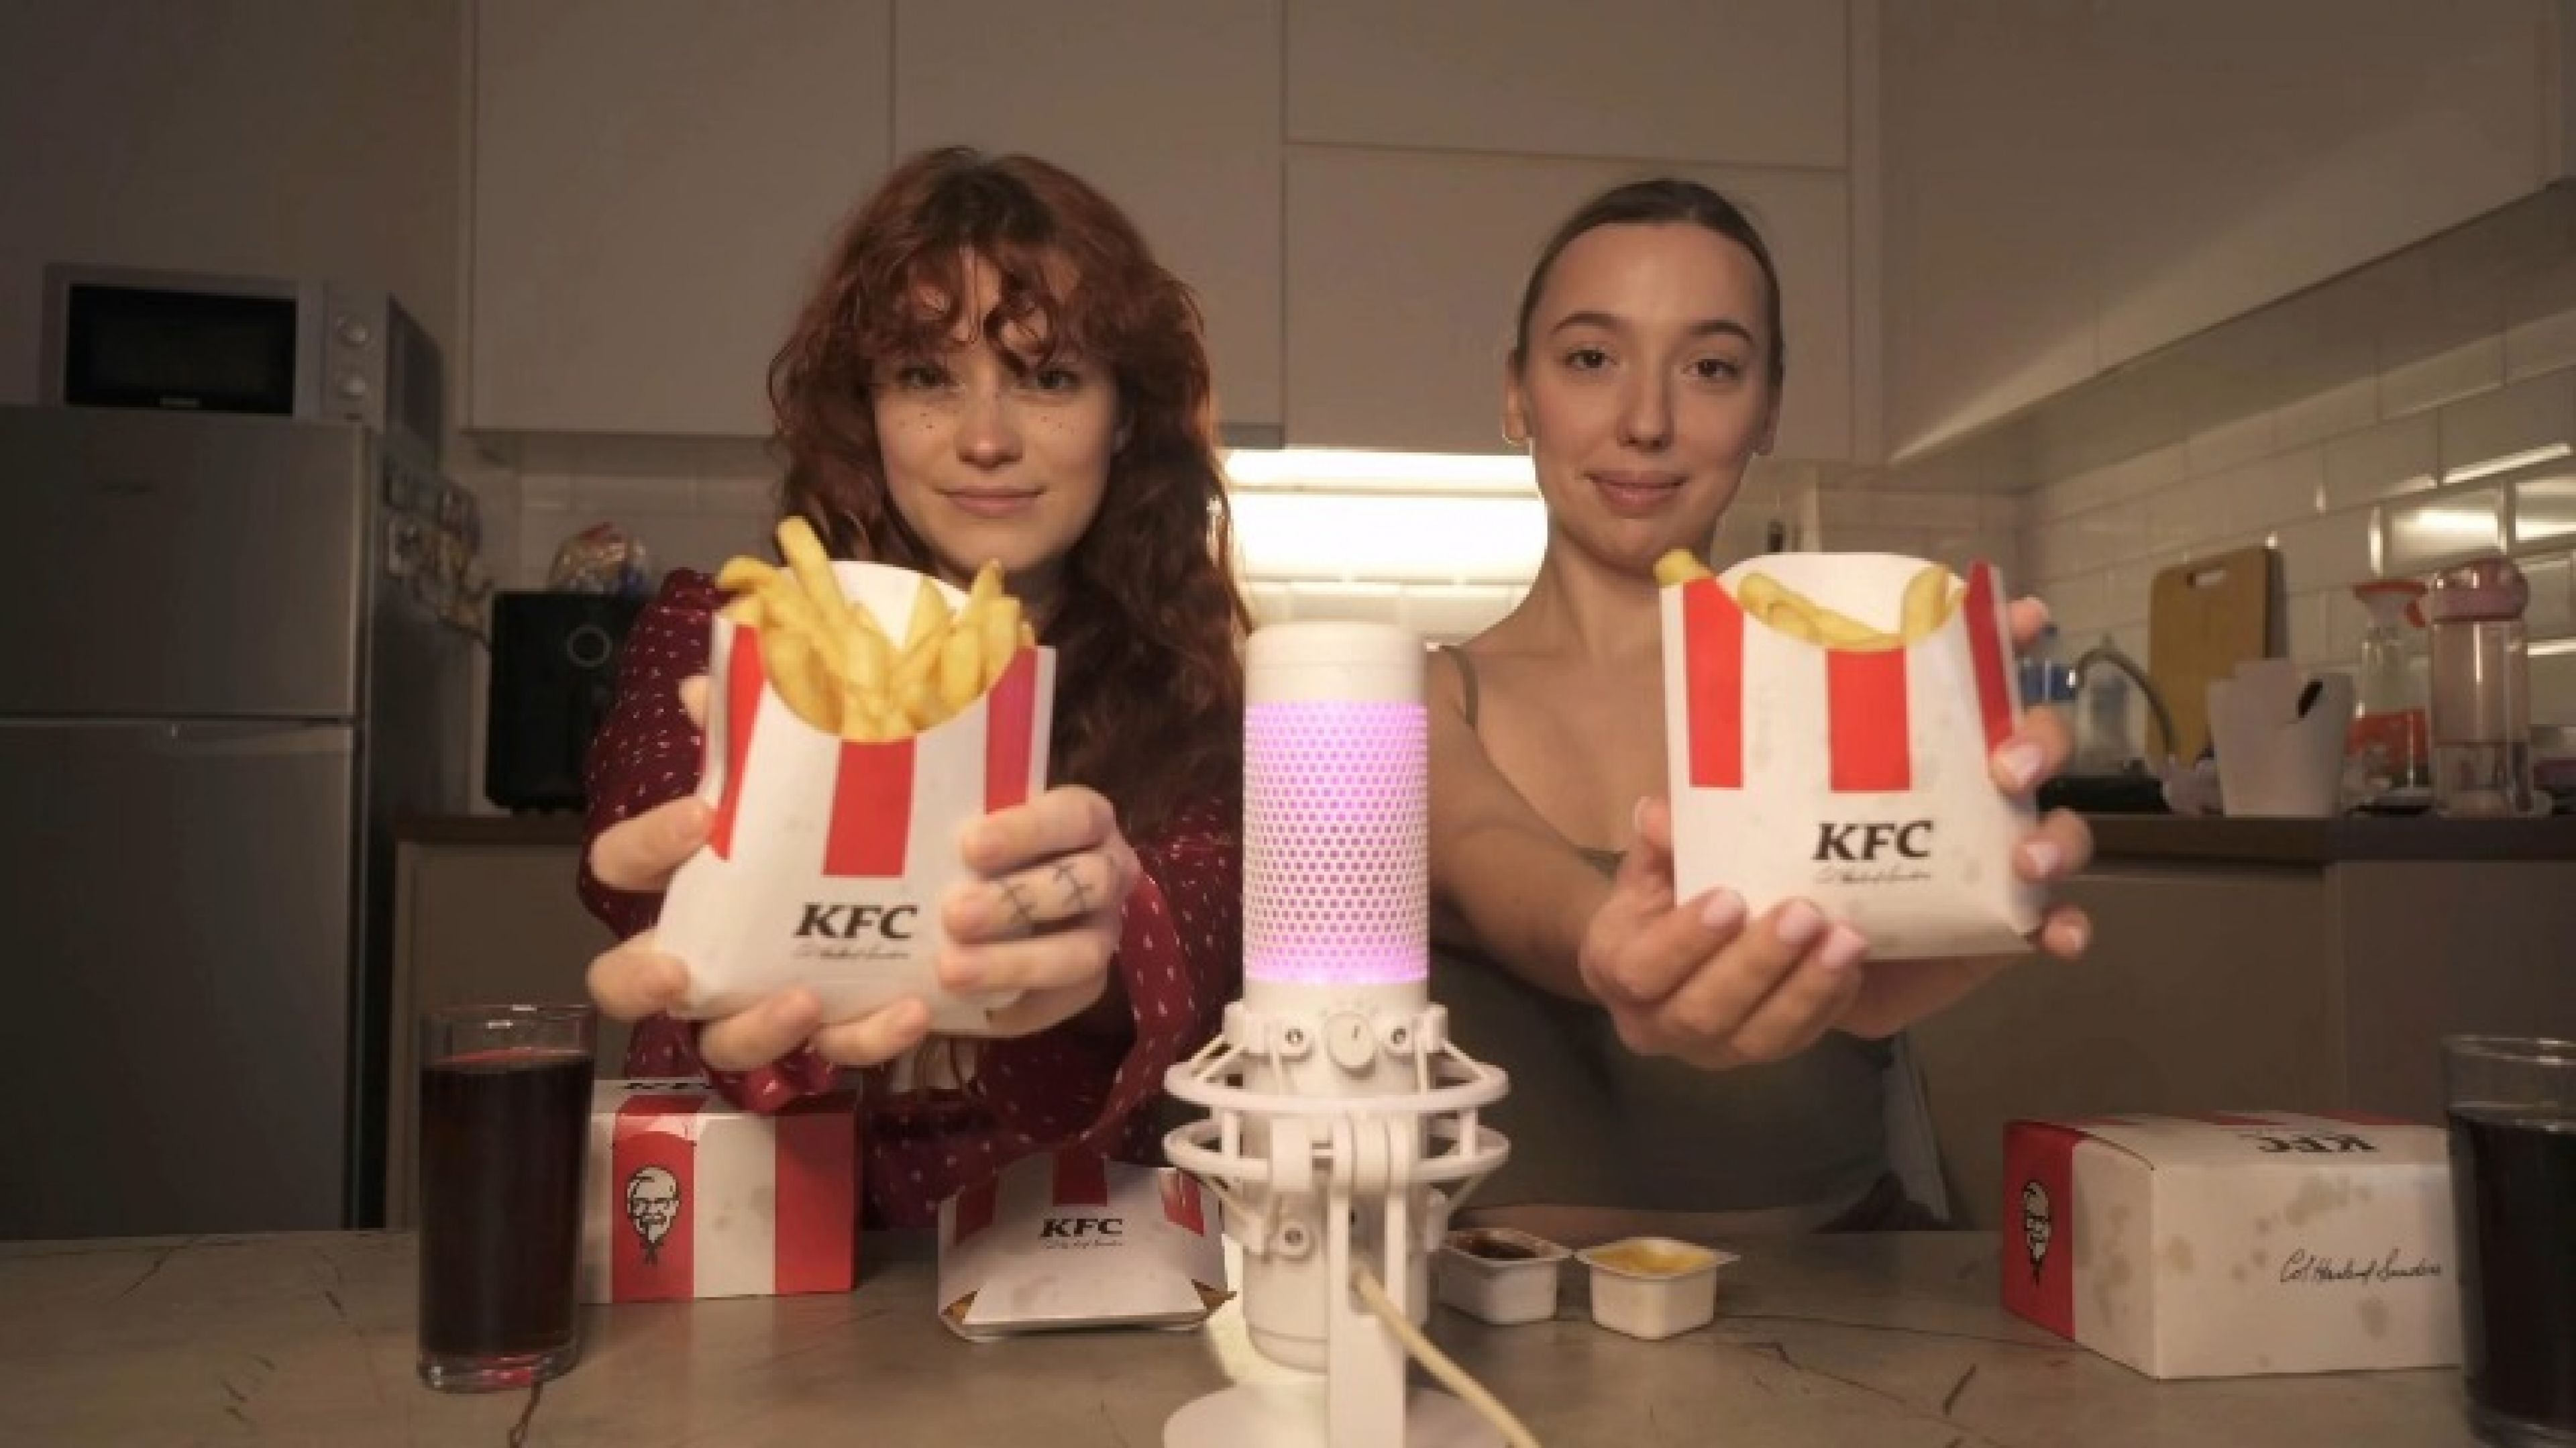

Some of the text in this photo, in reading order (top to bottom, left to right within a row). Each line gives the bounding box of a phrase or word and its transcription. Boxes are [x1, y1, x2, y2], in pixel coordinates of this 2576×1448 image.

[1811, 820, 1933, 862] KFC
[793, 902, 918, 940] KFC
[1038, 1218, 1123, 1239] KFC
